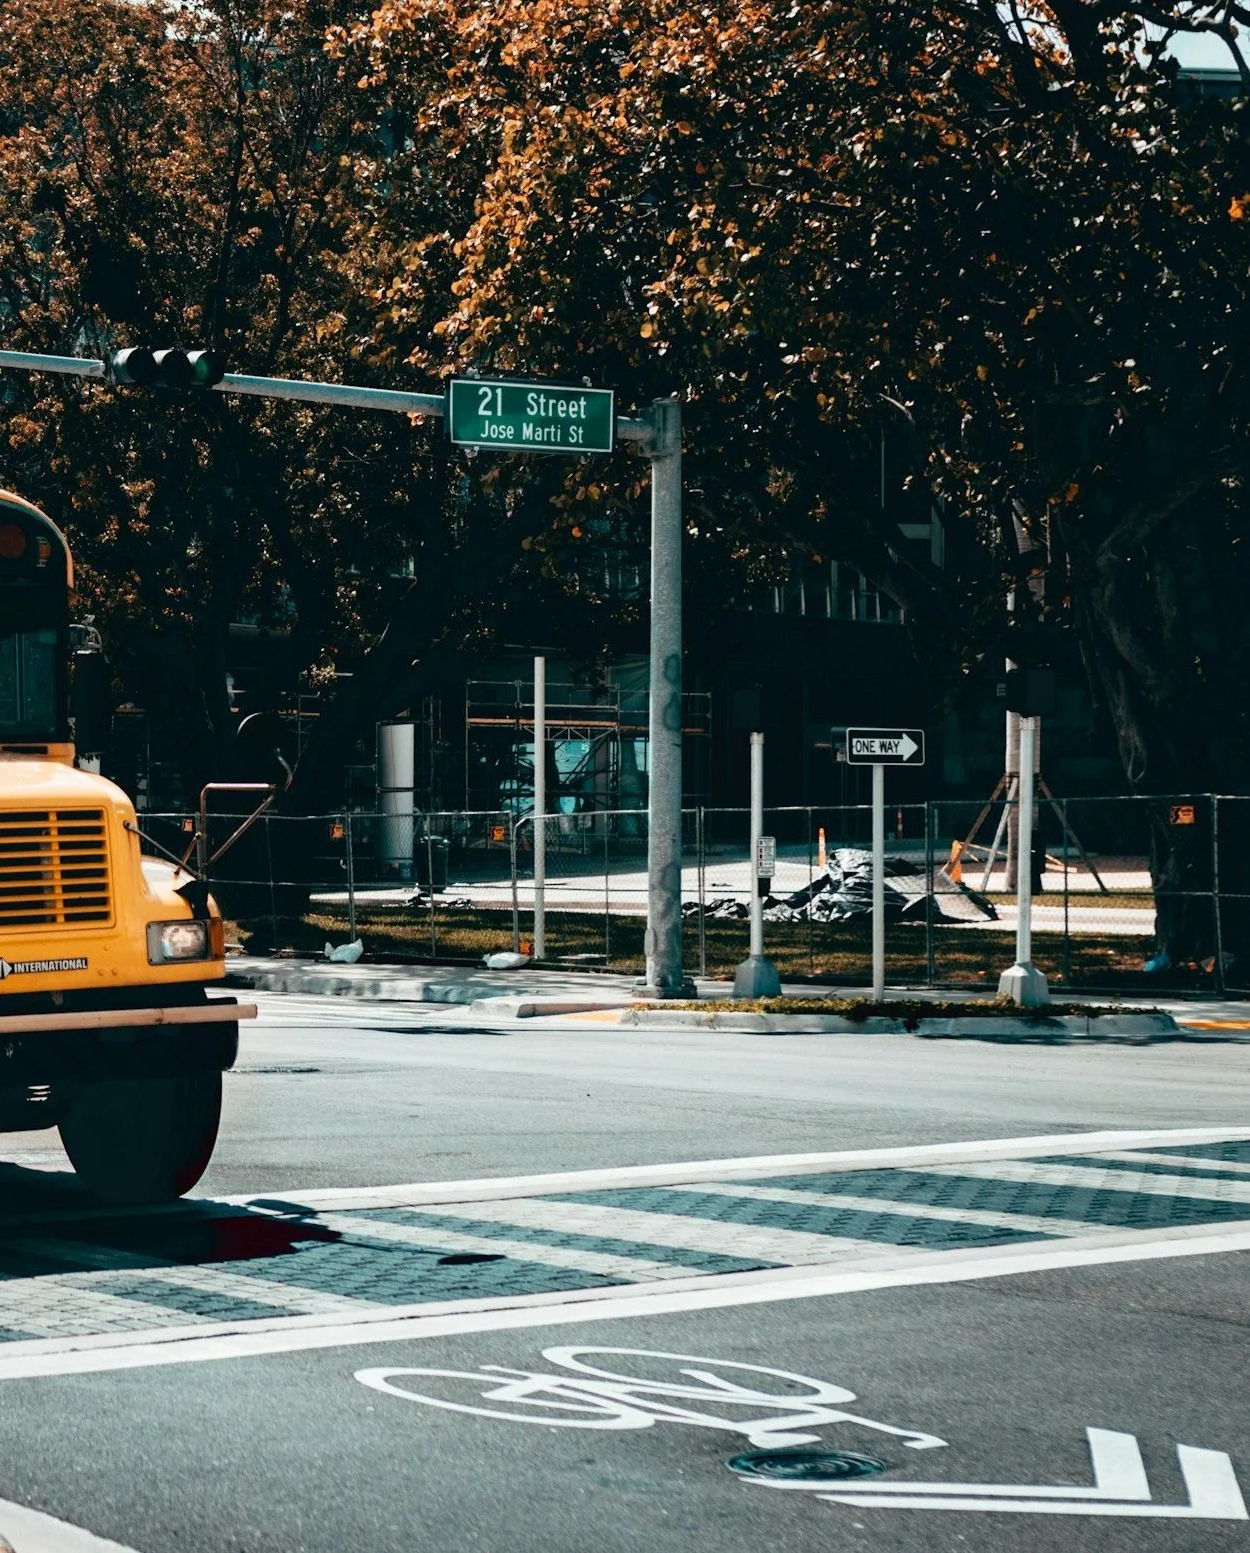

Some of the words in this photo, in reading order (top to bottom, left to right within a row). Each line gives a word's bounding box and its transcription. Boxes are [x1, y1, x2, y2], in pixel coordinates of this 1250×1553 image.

[478, 386, 502, 417] 21
[526, 392, 587, 419] Street
[480, 420, 515, 440] Jose
[522, 422, 561, 443] Marti
[568, 425, 584, 444] St
[855, 740, 876, 754] ONE
[879, 740, 900, 754] WAY
[14, 959, 88, 974] INTERNATIONAL
